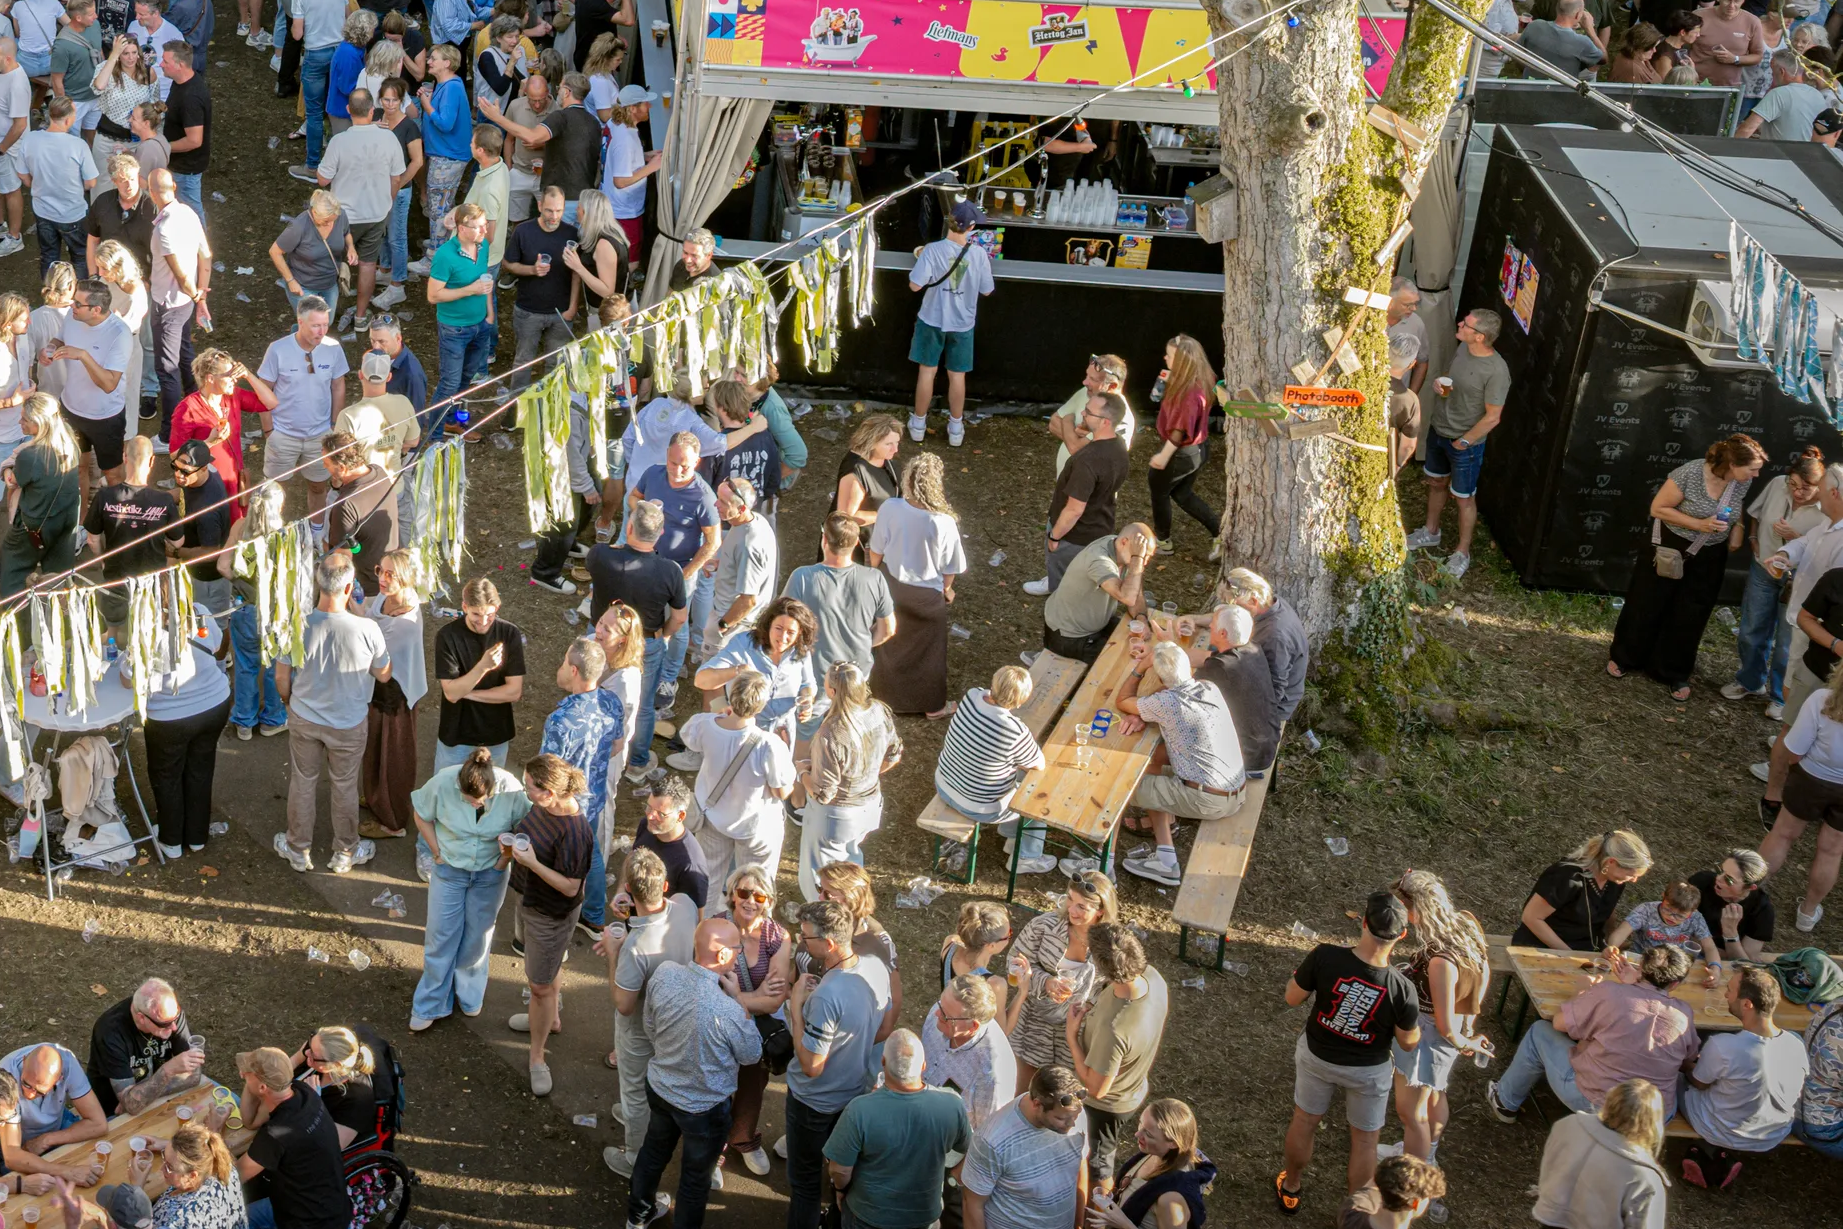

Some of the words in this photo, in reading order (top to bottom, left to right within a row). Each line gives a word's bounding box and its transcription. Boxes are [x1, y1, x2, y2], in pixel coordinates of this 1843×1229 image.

[927, 20, 979, 49] Liefmans
[1034, 30, 1065, 42] Hertog
[1065, 26, 1084, 38] Jan
[1626, 342, 1658, 351] Events
[1664, 382, 1677, 390] JV
[1679, 383, 1711, 393] Events
[1287, 389, 1359, 404] Photobooth
[1609, 415, 1641, 425] Events
[1717, 423, 1730, 431] JV
[1732, 424, 1764, 433] Events
[1592, 487, 1622, 496] Events
[1333, 981, 1365, 1028] NOTORIOUS
[1321, 1017, 1341, 1032] LIVE
